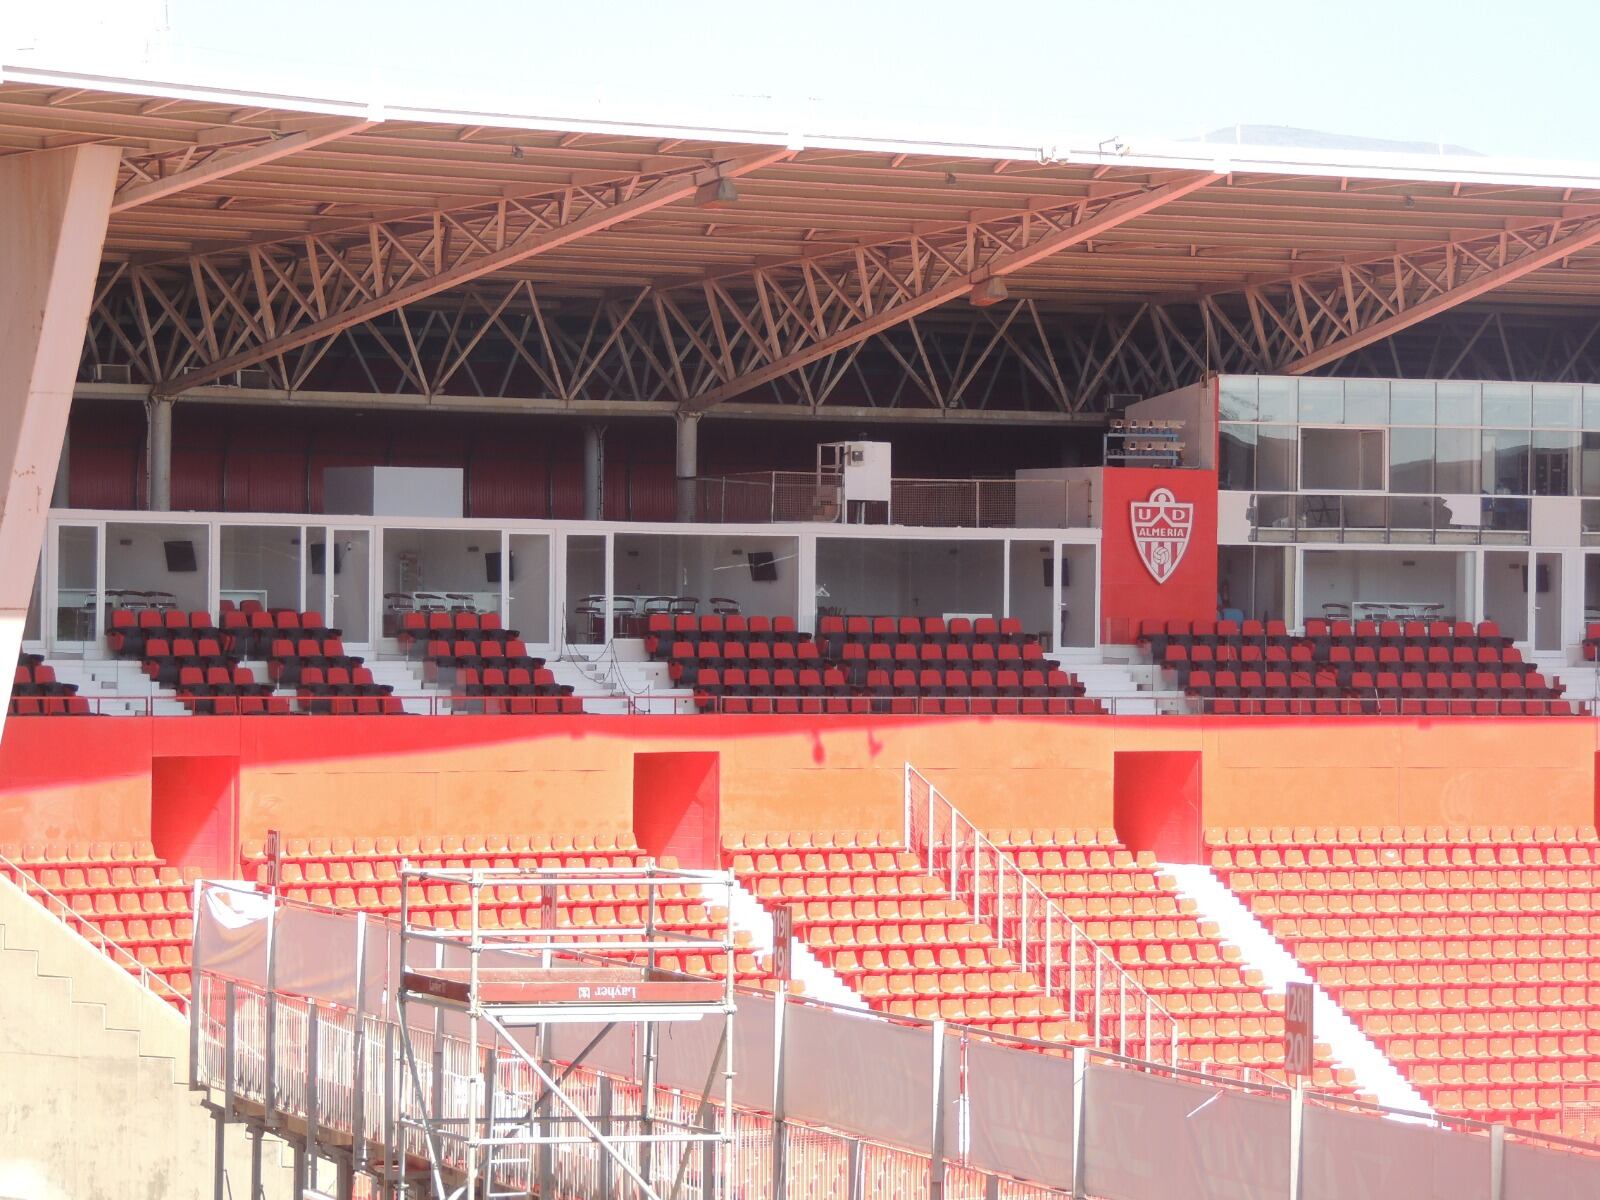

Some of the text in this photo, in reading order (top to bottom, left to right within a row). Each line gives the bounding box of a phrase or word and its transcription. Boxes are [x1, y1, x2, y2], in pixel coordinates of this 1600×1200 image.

[1138, 508, 1186, 521] U D
[1138, 527, 1185, 538] ALMERIA
[594, 984, 637, 999] Layher
[1289, 986, 1305, 1022] 20
[1285, 1031, 1304, 1073] 20
